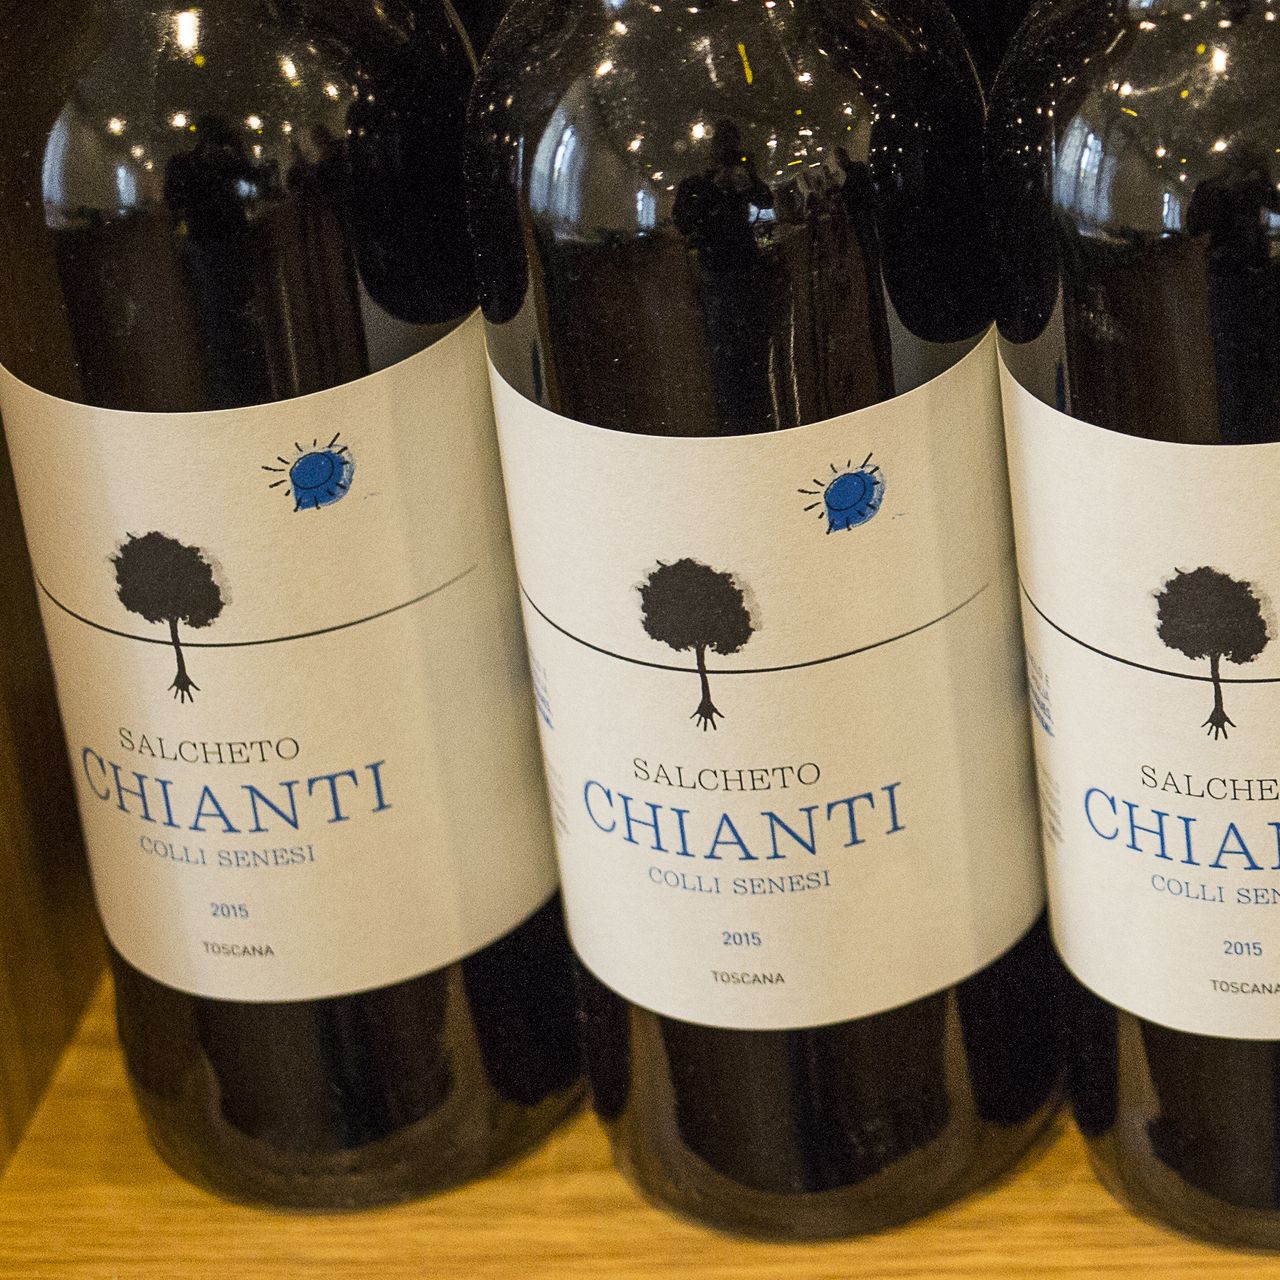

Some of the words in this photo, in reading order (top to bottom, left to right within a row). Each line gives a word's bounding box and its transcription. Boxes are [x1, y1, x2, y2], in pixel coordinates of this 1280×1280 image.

[114, 726, 301, 767] SALCHETO
[633, 757, 821, 792] SALCHETO
[82, 746, 392, 835] CHIANTI
[584, 778, 905, 861] CHIANTI
[139, 834, 208, 867] COLLI
[217, 843, 316, 868] SENESI
[647, 865, 721, 895] COLLI
[732, 869, 832, 896] SENESI
[1150, 873, 1225, 904] COLLI
[210, 902, 250, 920] 2015
[202, 940, 275, 958] TOSCANA
[722, 930, 762, 947] 2015
[1223, 939, 1264, 958] 2015
[712, 970, 785, 985] TOSCANA
